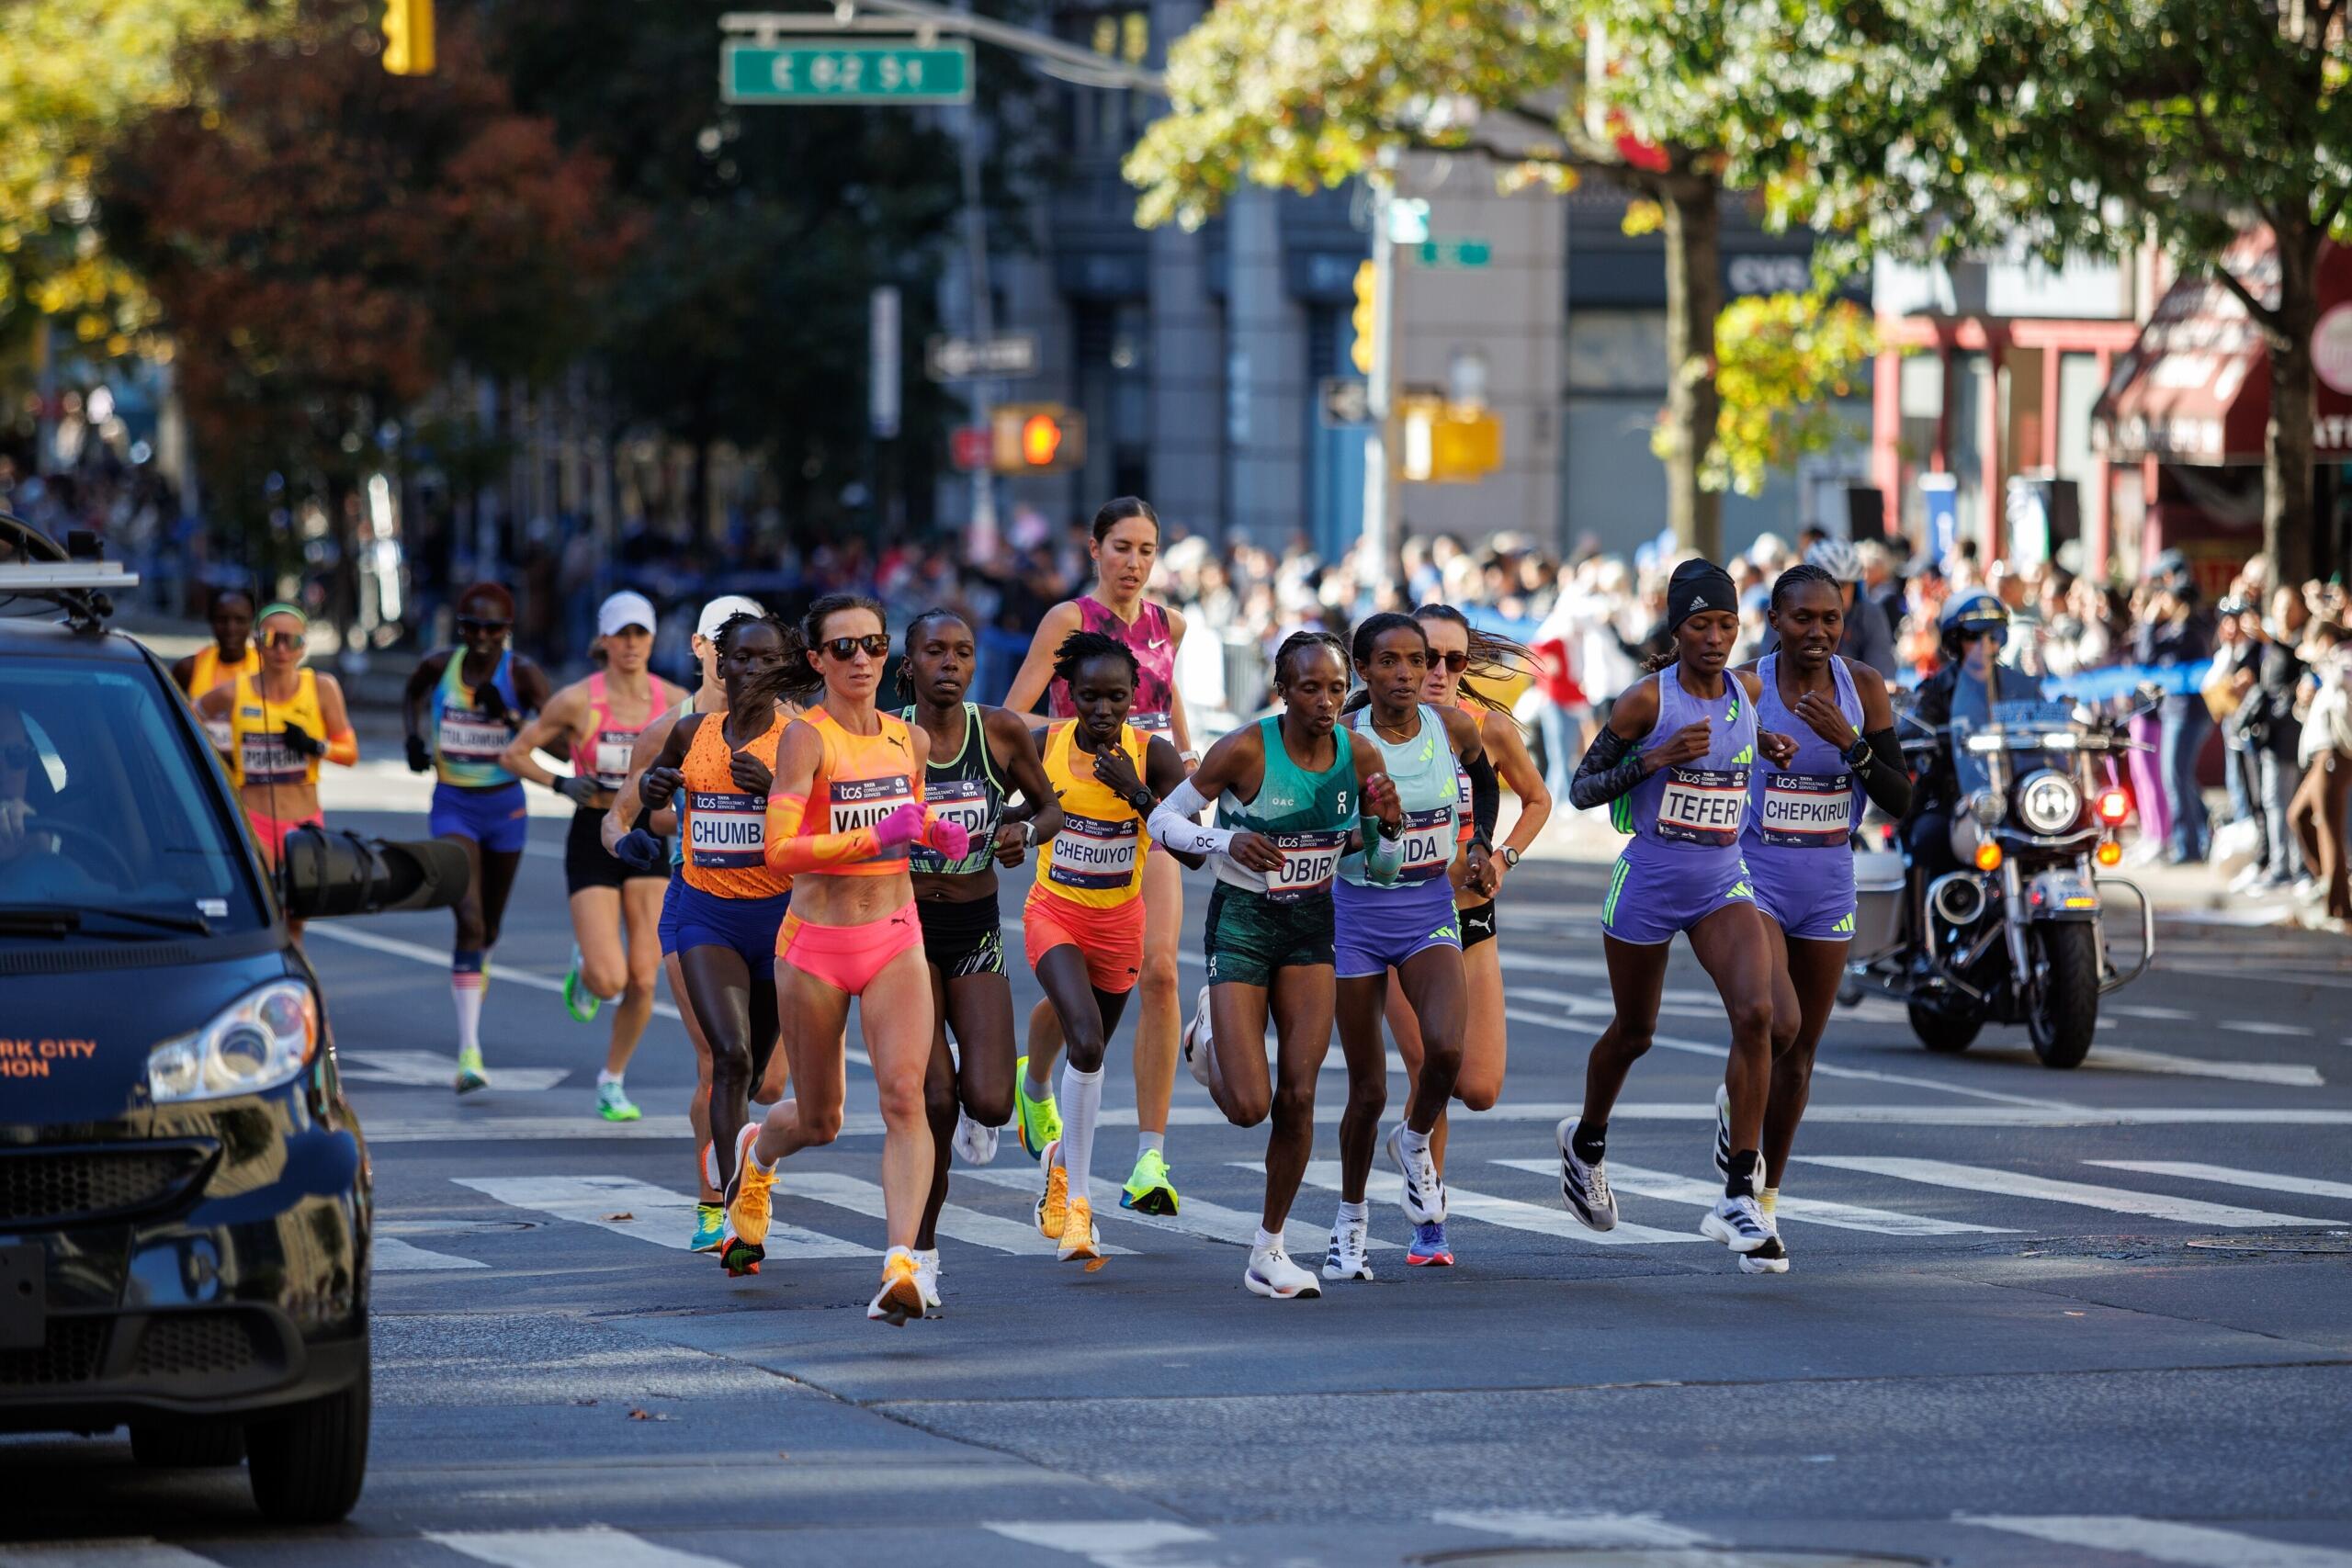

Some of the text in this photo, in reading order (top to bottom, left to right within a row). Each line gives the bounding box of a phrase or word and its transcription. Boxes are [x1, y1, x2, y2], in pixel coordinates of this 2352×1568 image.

[773, 55, 793, 91] E
[1679, 771, 1700, 784] tcs
[1776, 774, 1797, 789] tcs
[841, 785, 862, 800] tcs
[697, 795, 716, 809] tcs
[1272, 797, 1295, 807] OAC
[1670, 792, 1742, 824] TEFERI
[1766, 800, 1849, 822] CHEPKIRUI
[693, 820, 765, 844] CHUMB
[1065, 815, 1084, 831] tcs
[1278, 835, 1299, 848] tcs
[1055, 839, 1136, 863] CHERUIYOT
[1279, 854, 1337, 884] OBIRI
[39, 1039, 97, 1059] CITY
